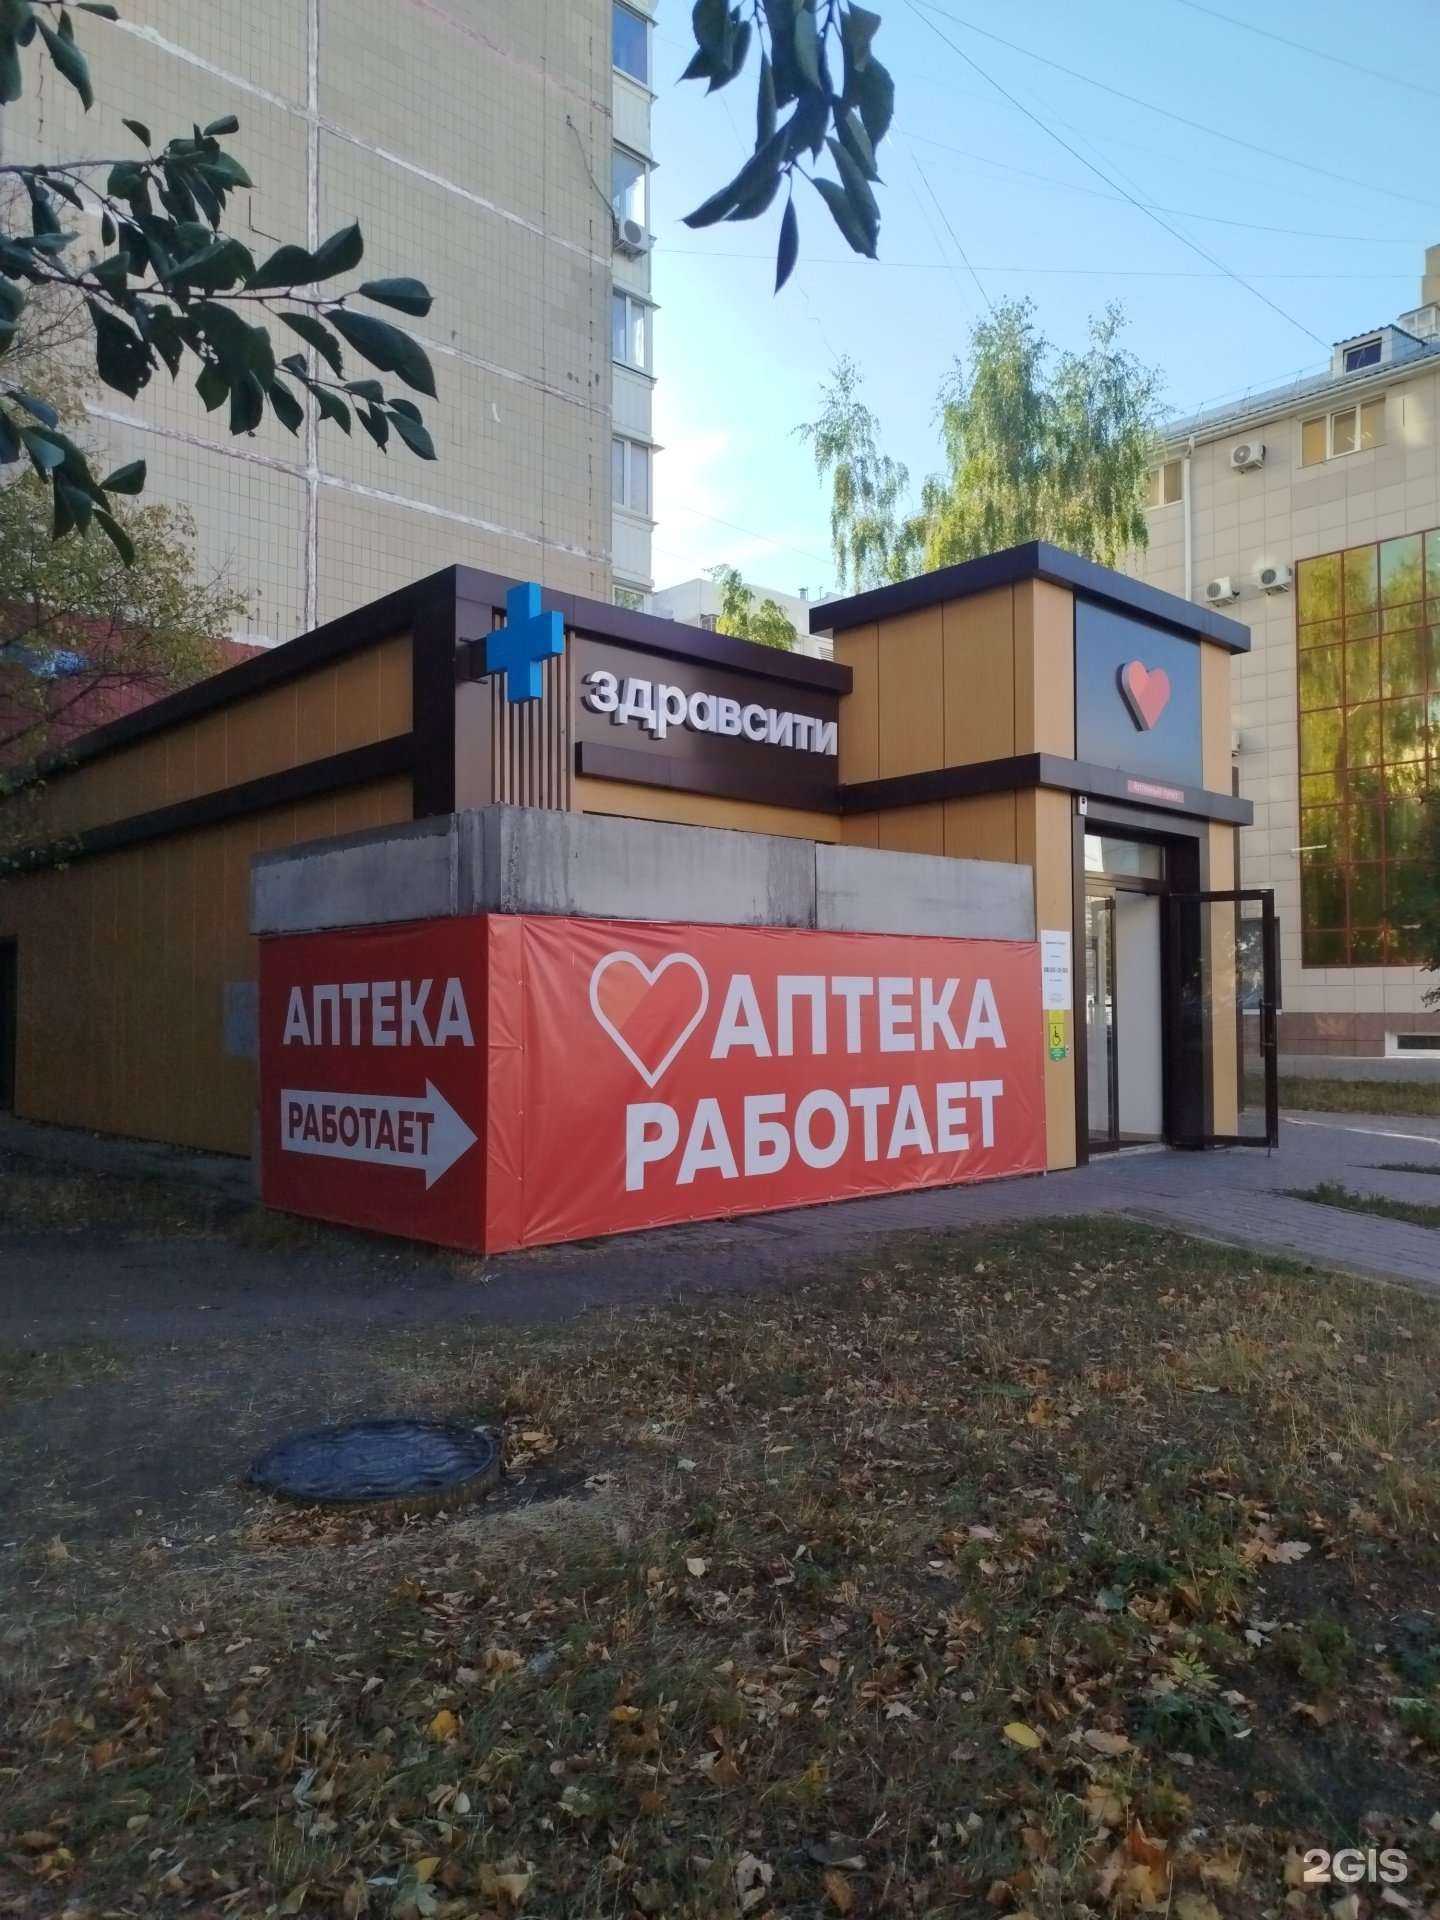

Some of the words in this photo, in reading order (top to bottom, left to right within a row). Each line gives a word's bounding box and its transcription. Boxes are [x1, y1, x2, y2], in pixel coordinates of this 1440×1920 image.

[585, 670, 838, 756] здравсити
[282, 976, 475, 1047] АПТЕКА
[710, 974, 1007, 1059] АПТЕКА
[288, 1101, 435, 1155] РАБОТАЕТ
[625, 1079, 1003, 1191] РАБОТАЕТ
